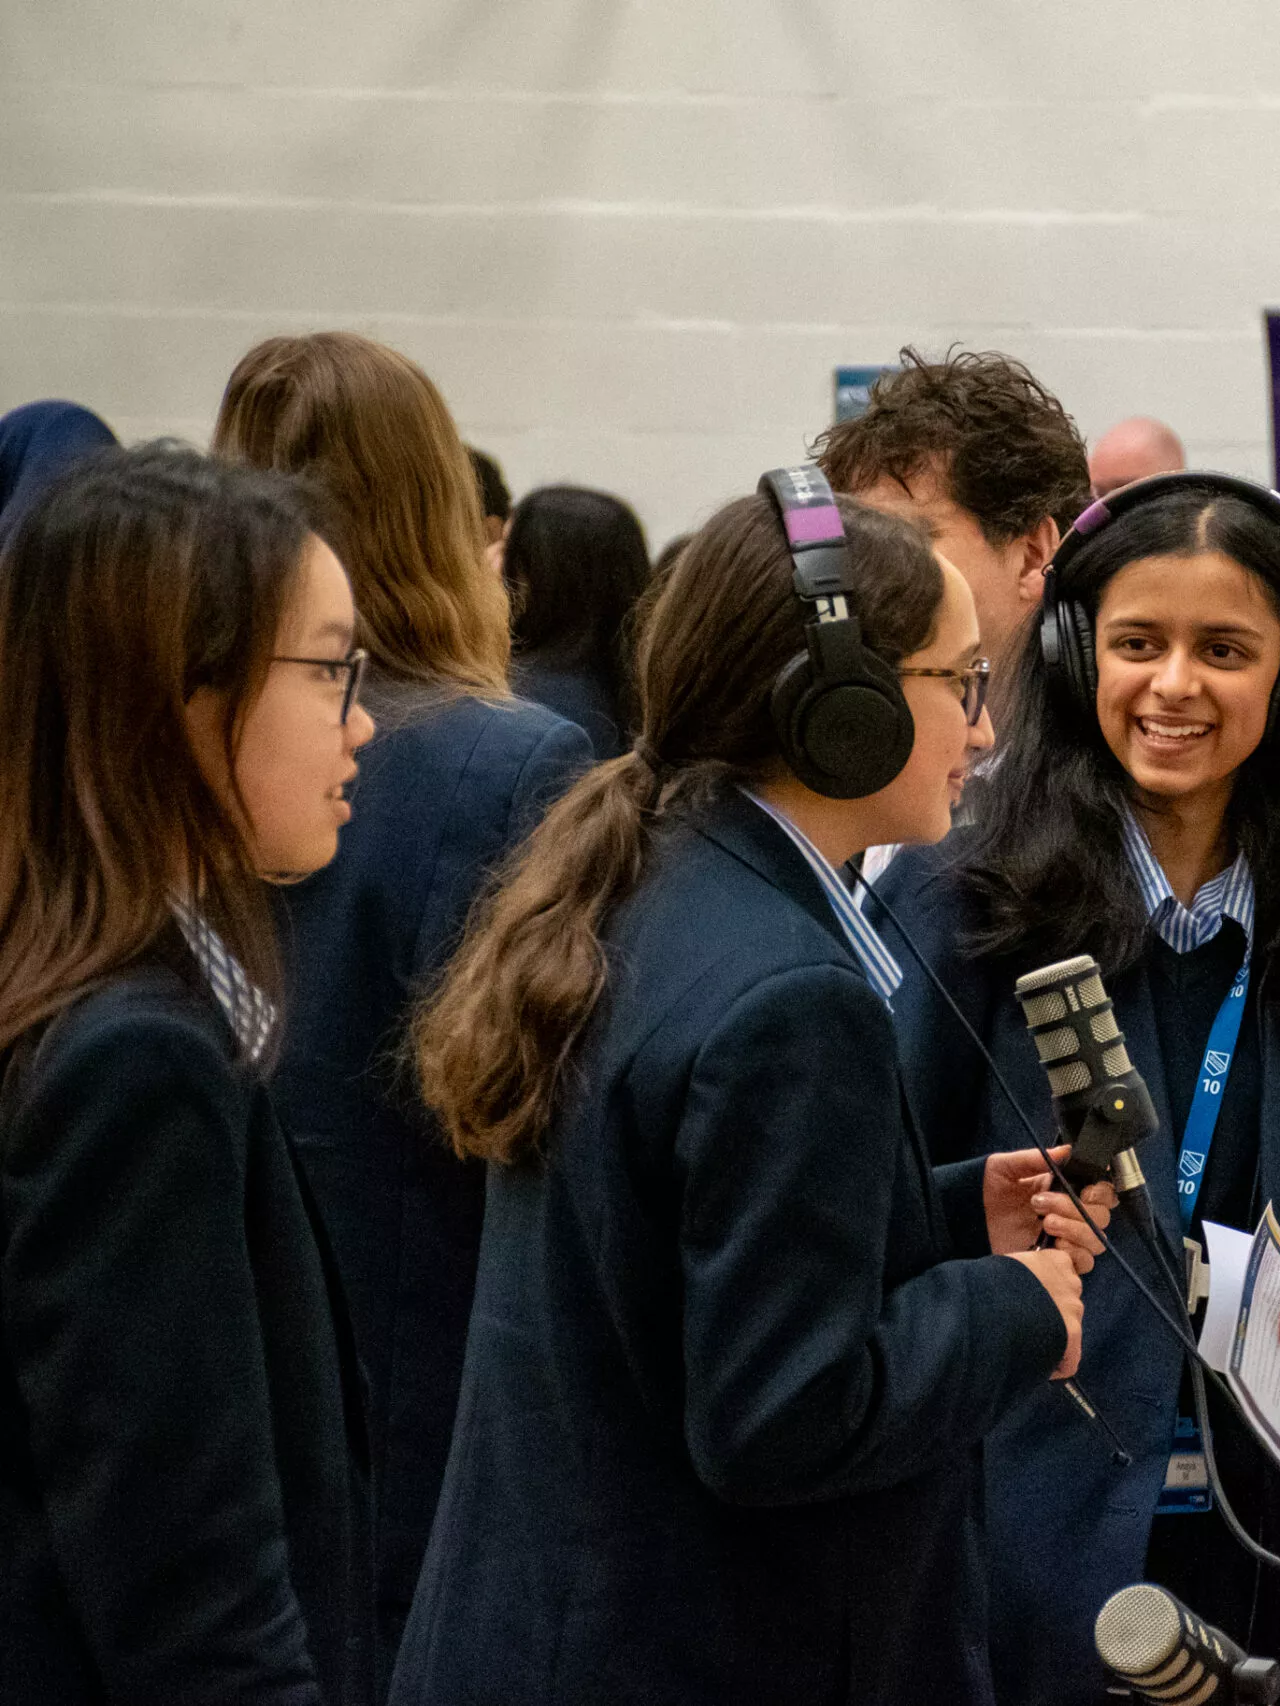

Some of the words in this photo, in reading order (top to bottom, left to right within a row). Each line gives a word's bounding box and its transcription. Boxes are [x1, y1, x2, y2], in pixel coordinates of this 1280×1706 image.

[1229, 984, 1244, 998] 10
[1203, 1079, 1221, 1095] 10
[1177, 1179, 1195, 1195] 10
